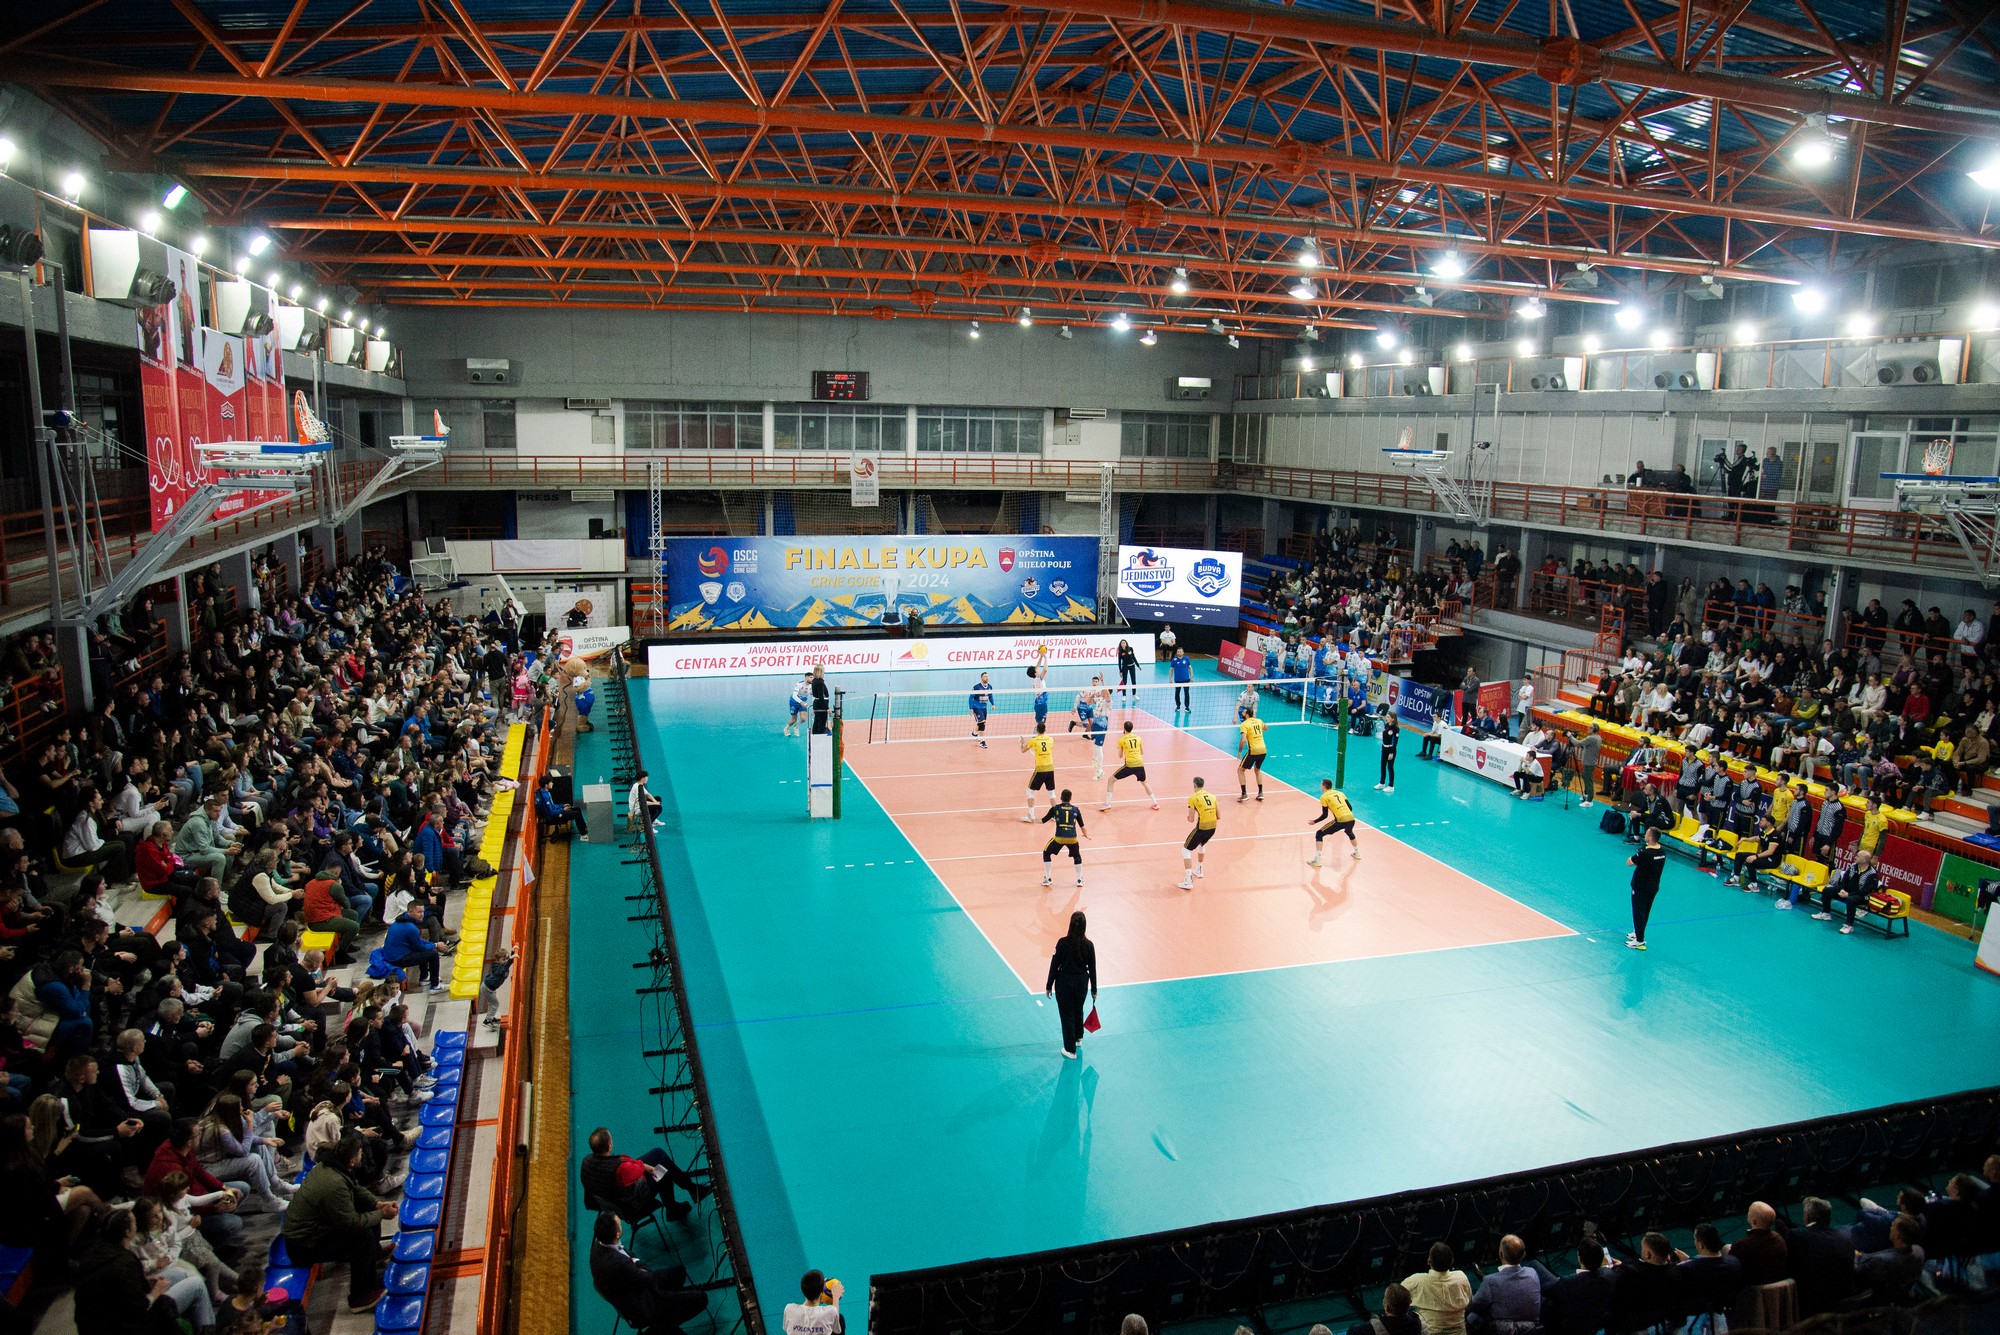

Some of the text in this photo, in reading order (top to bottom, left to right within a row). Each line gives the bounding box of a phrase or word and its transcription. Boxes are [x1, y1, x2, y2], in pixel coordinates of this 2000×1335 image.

[734, 550, 758, 561] OSCG
[785, 547, 989, 570] FINALE KUPA
[1018, 549, 1055, 558] OPŠTINA
[1018, 561, 1072, 569] BIJELO POLJE
[1197, 565, 1222, 575] BUDVA
[906, 573, 950, 588] 2024
[1124, 569, 1171, 581] JEDINSTVO
[810, 575, 880, 588] CRNE GORE
[578, 641, 615, 650] BIJELO POLJE
[1014, 638, 1087, 647] JAVNA USTANOVA
[747, 644, 829, 655] JAVNA USTANOVA
[947, 650, 995, 662] CENTAR
[997, 650, 1013, 661] ZA
[1016, 648, 1054, 660] SPOT
[1055, 648, 1060, 659] I
[675, 652, 880, 670] CENTAR ZA SPORT I REKREACIJU
[1414, 687, 1433, 699] OPŠTIN
[1398, 694, 1450, 723] BIJELO POJE
[1253, 725, 1261, 735] 14
[1041, 742, 1047, 752] 8
[1129, 739, 1137, 749] 17
[1204, 795, 1211, 806] 6
[1333, 795, 1342, 804] 7
[1065, 811, 1069, 823] 1
[1843, 850, 1854, 862] ZA
[1880, 863, 1922, 886] REKREACIJU
